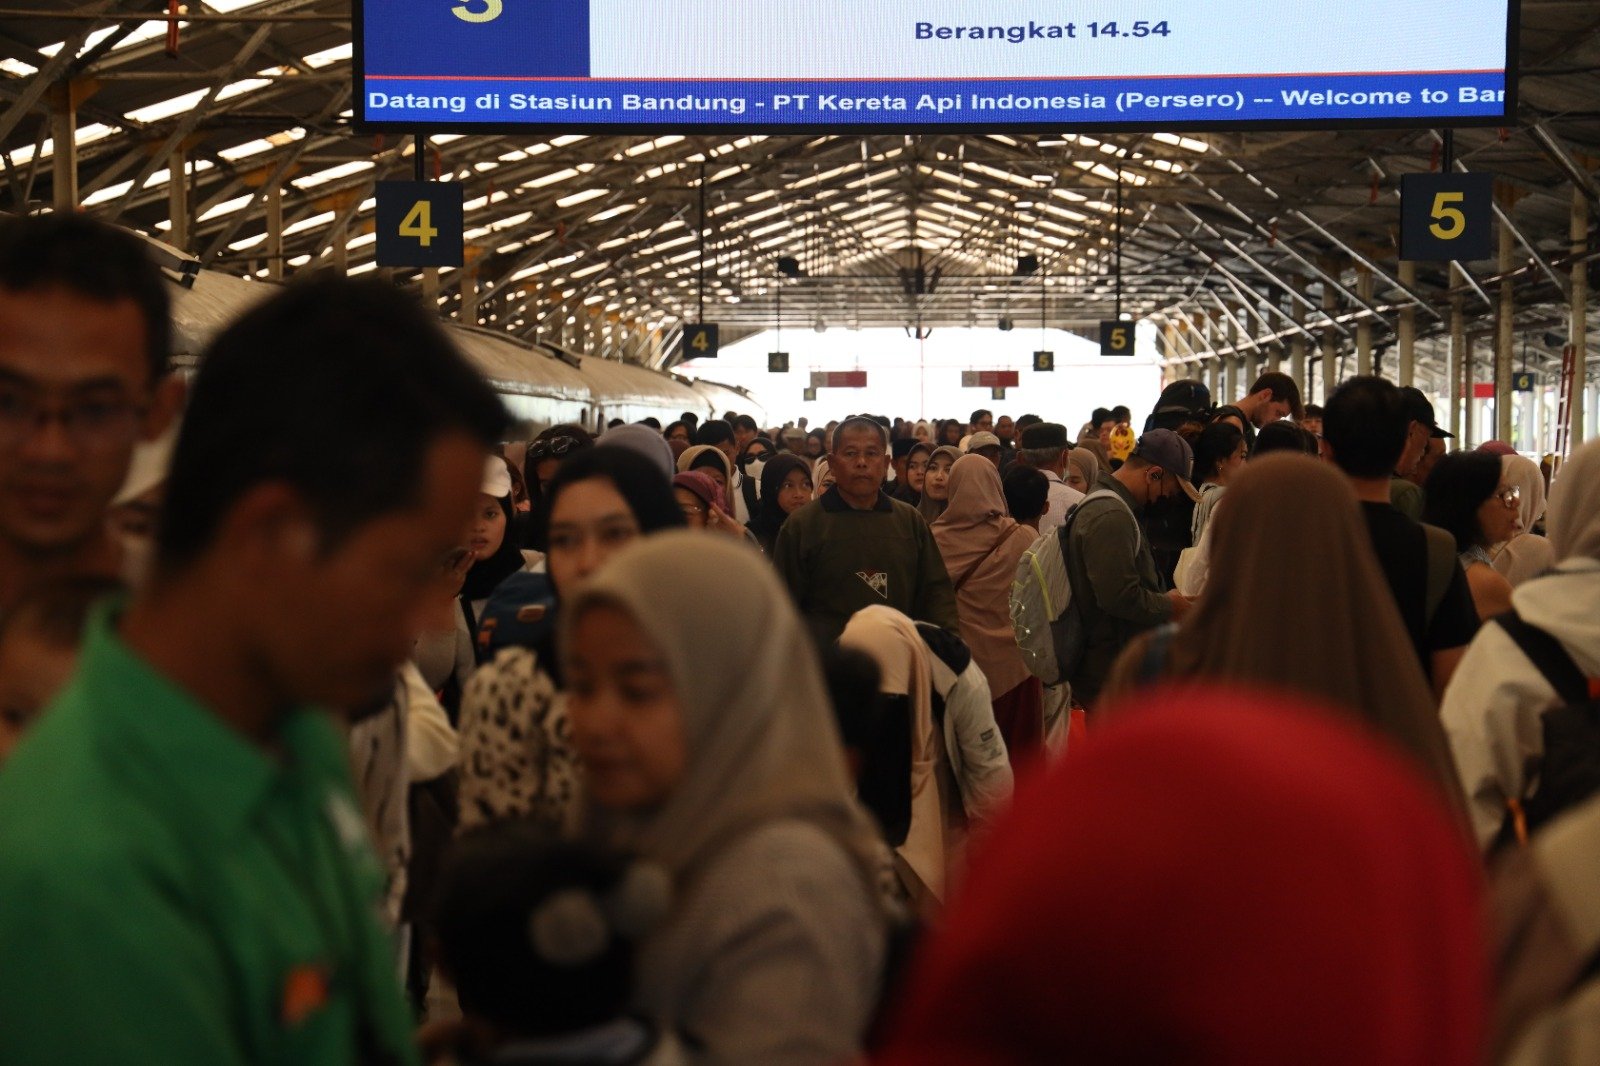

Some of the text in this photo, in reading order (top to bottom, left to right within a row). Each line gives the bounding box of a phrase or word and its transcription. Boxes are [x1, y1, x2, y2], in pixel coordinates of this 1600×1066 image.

[915, 20, 1172, 44] Berangkat 14.54
[369, 92, 466, 113] Datang
[475, 92, 500, 110] di
[509, 93, 612, 110] Stasiun
[622, 94, 746, 115] Bandung
[773, 94, 810, 111] PT
[818, 94, 907, 111] Kereta
[915, 94, 962, 114] Api
[971, 93, 1106, 110] Indonesia
[1115, 91, 1244, 112] (Persero)
[1281, 89, 1412, 106] Welcome
[1420, 88, 1449, 104] to
[397, 200, 438, 247] 4
[1429, 191, 1466, 240] 5
[691, 331, 709, 351] 4
[1111, 328, 1126, 349] 5
[1038, 354, 1050, 369] 5
[1519, 376, 1529, 388] 6
